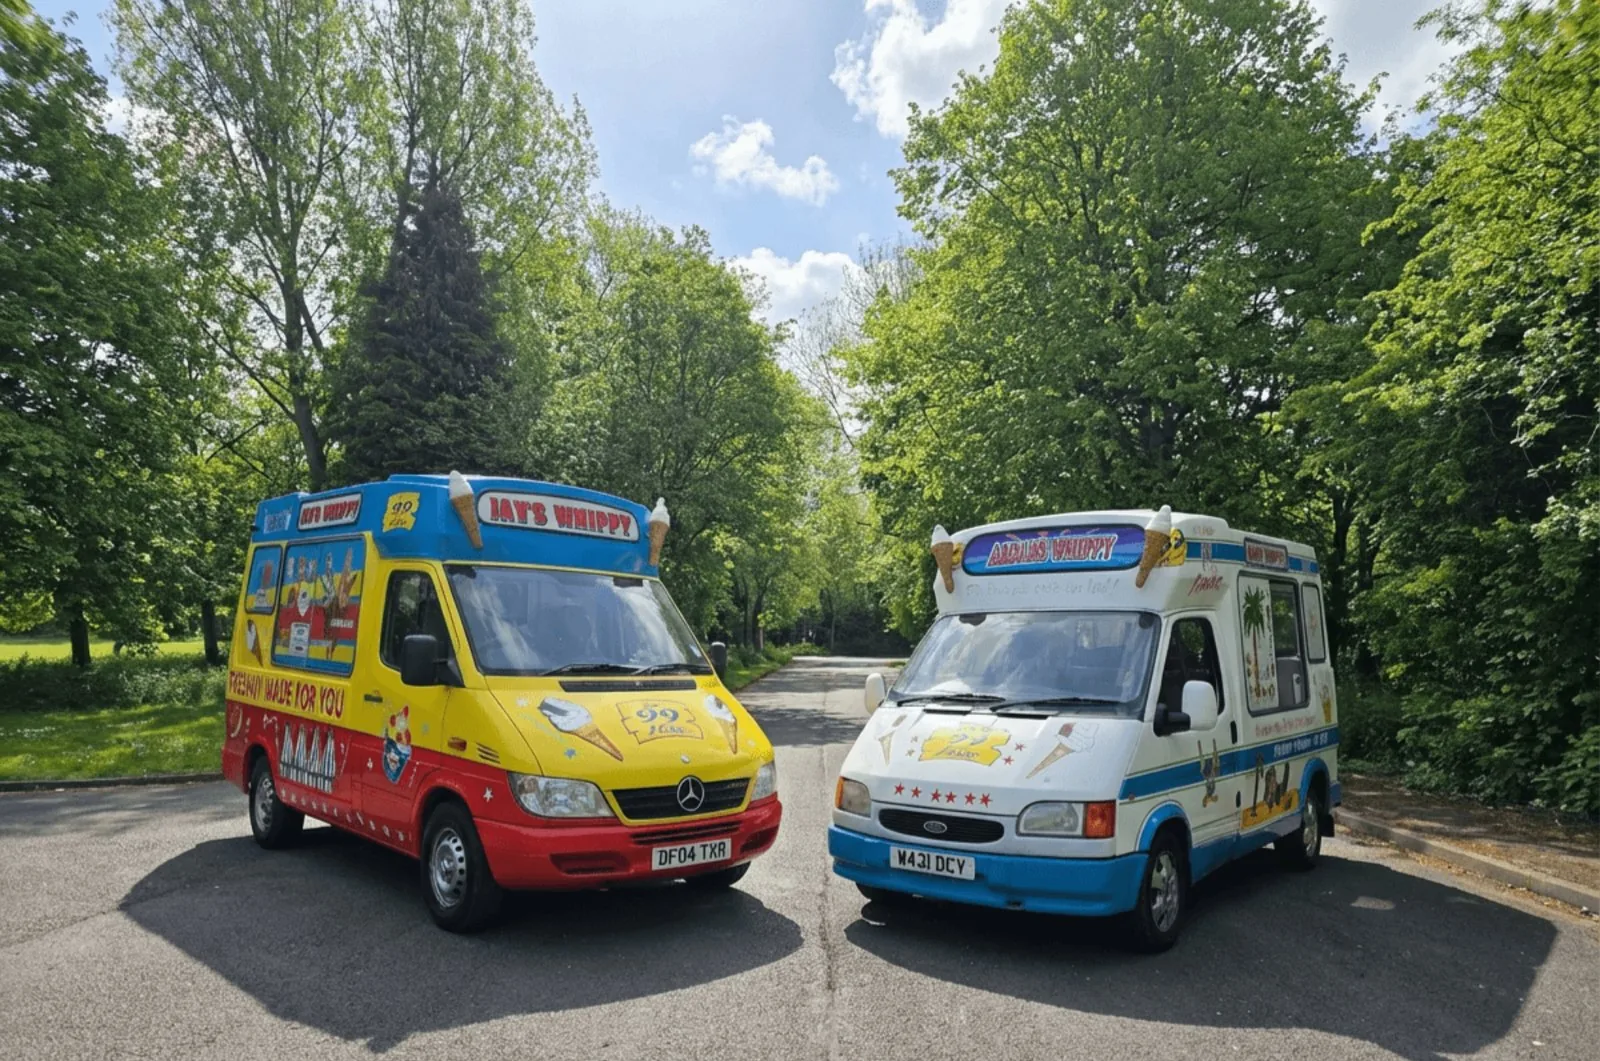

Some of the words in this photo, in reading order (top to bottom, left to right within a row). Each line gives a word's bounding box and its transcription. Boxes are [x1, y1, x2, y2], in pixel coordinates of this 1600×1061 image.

[553, 503, 631, 538] WHIPPY
[320, 685, 345, 719] YOU
[657, 846, 696, 866] DF04
[700, 841, 727, 861] TXR
[935, 855, 966, 875] DCY
